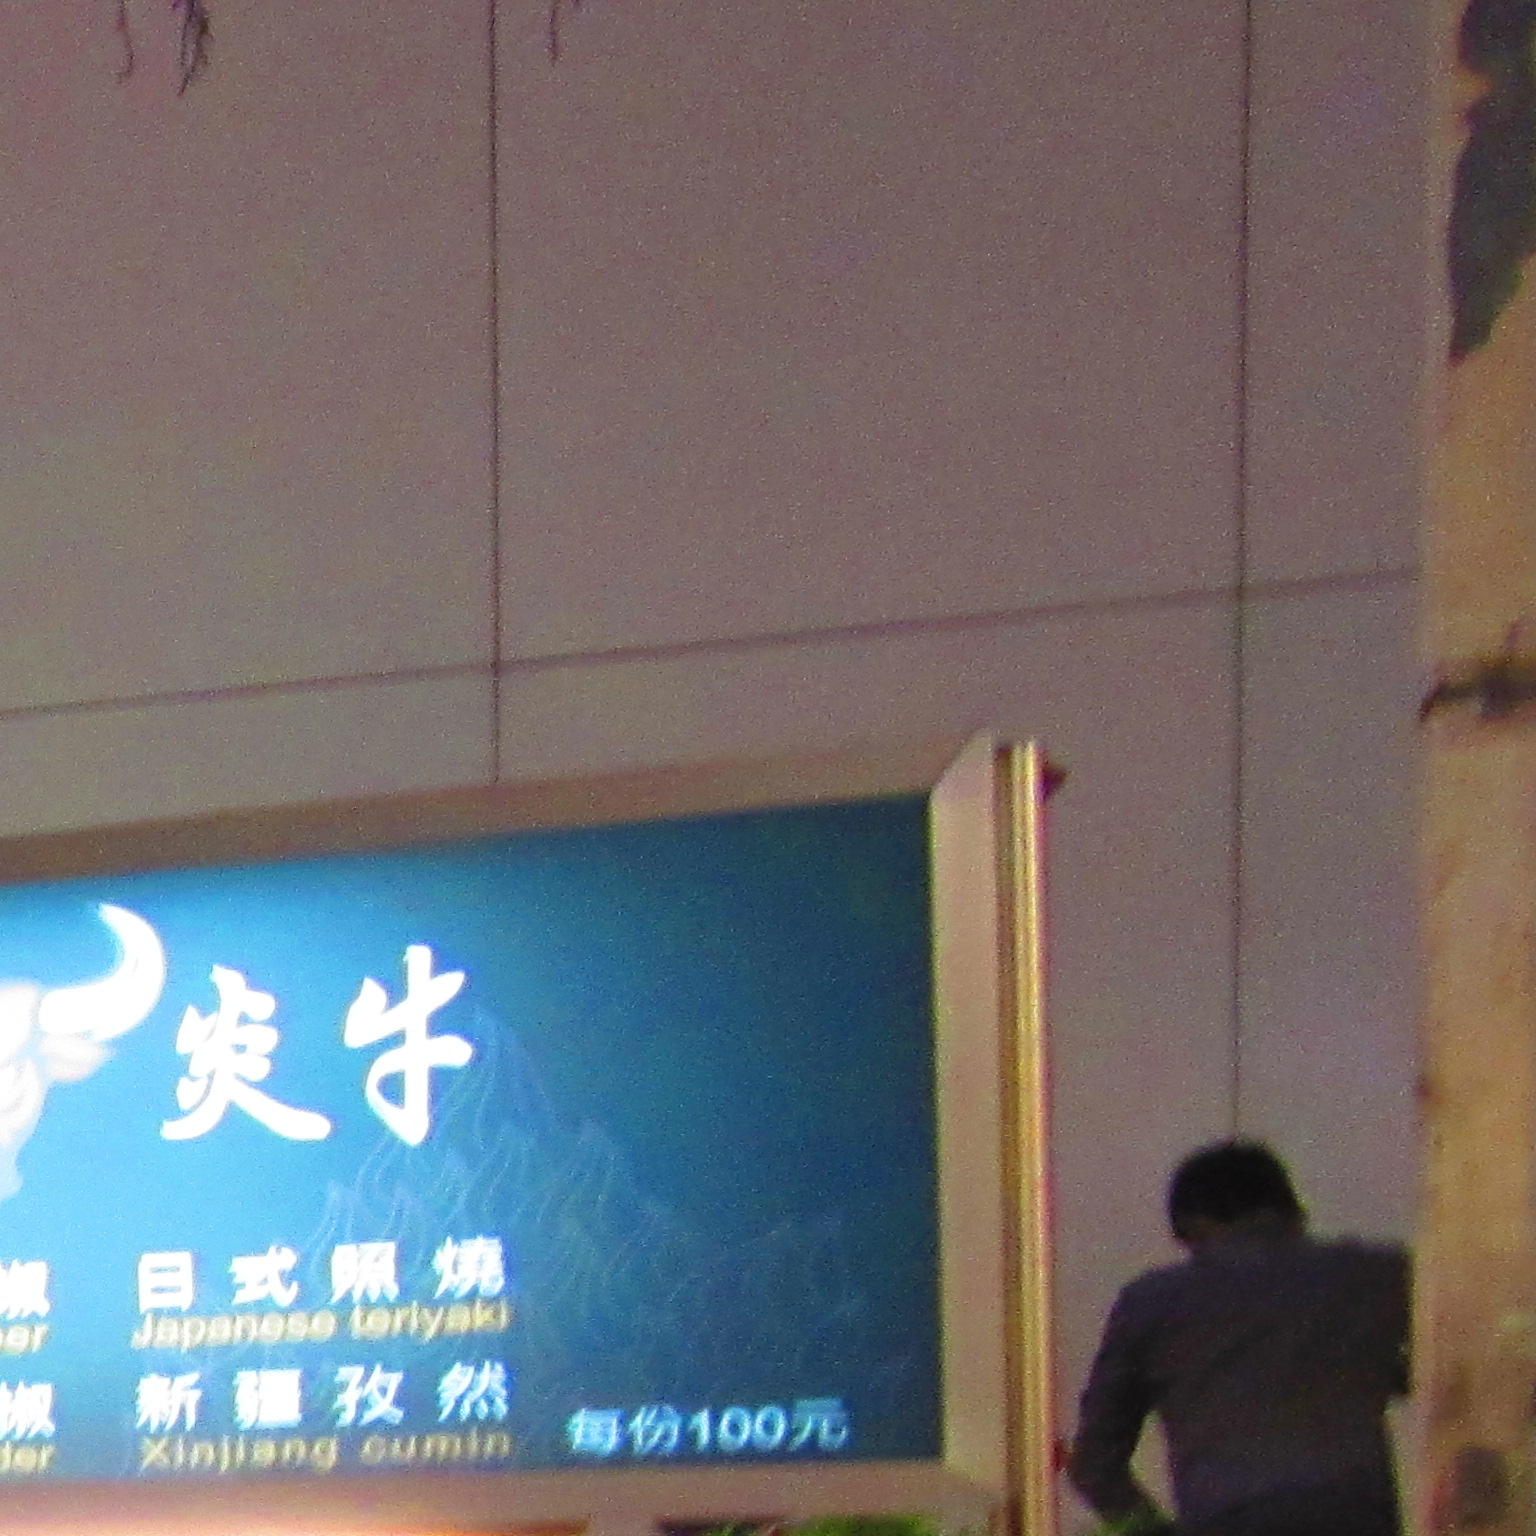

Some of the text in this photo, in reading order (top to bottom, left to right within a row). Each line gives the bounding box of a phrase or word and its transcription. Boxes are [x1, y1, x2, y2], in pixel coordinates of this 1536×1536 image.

[137, 1235, 506, 1313] 日式照燒
[131, 1298, 509, 1352] Japanese teriyaki
[136, 1361, 509, 1433] 新疆孜然
[140, 1427, 511, 1477] Xinjiang cumin
